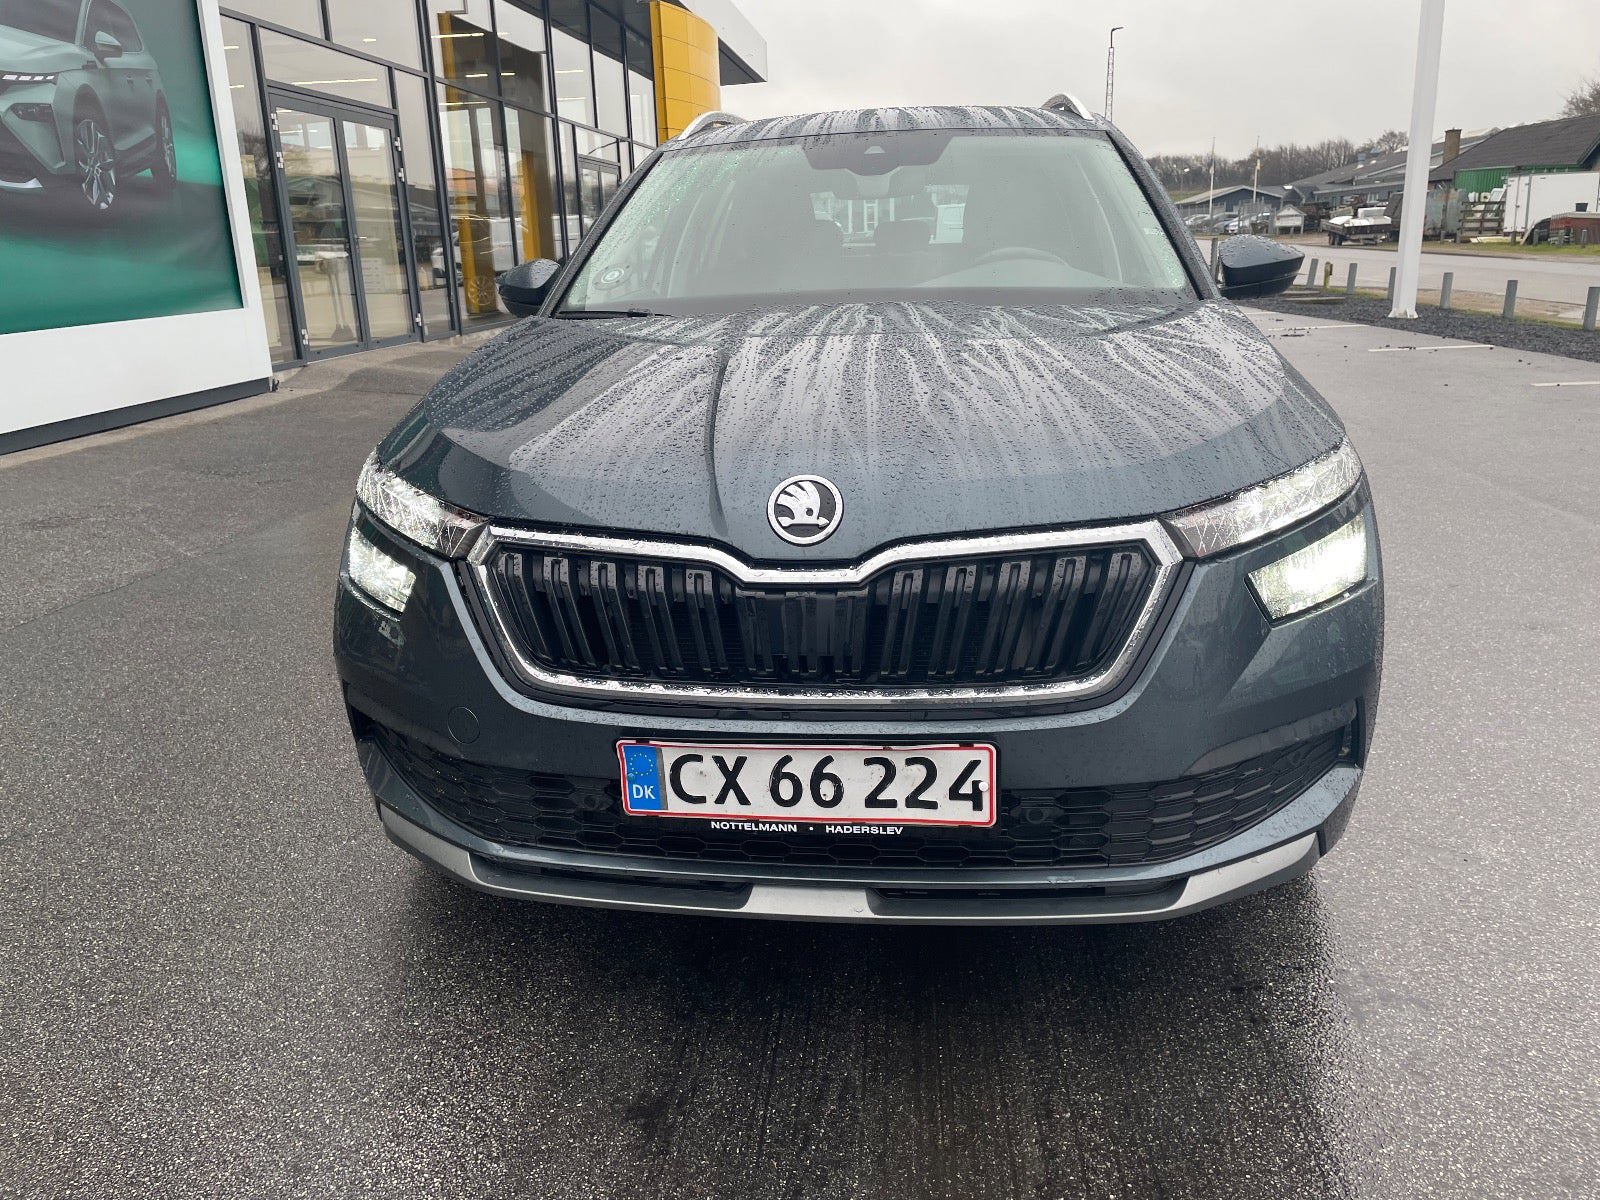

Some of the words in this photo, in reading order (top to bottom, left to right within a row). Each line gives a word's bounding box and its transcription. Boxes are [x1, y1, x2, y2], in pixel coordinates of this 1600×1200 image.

[669, 754, 752, 805] CX
[768, 755, 845, 809] 66
[863, 757, 984, 811] 224
[632, 784, 656, 800] DK
[710, 821, 798, 833] NOTTELMANN
[825, 825, 904, 835] HADERSLEV
